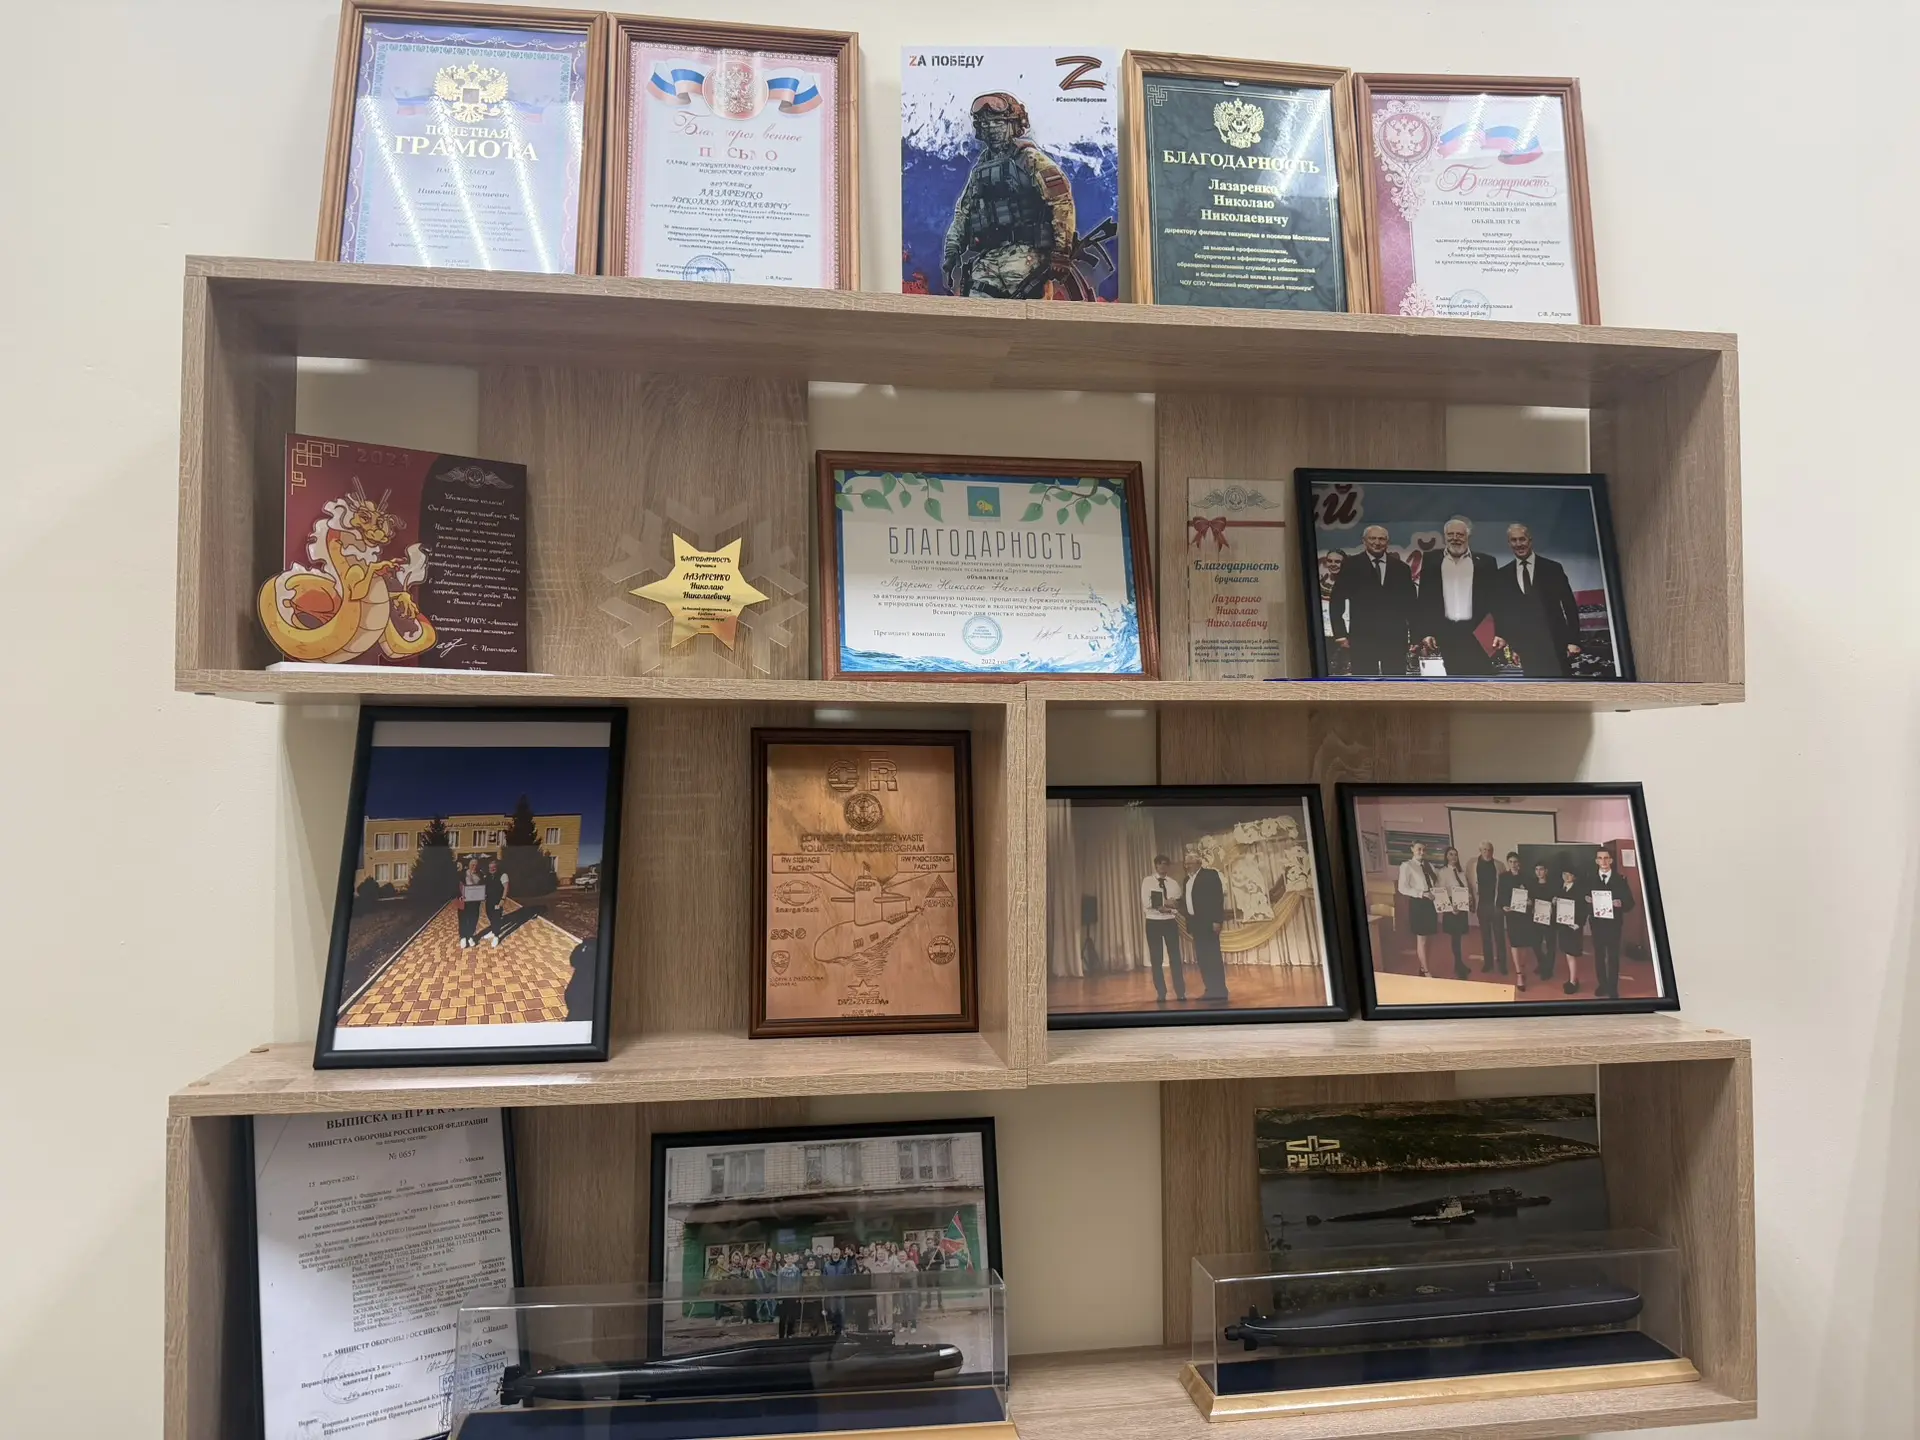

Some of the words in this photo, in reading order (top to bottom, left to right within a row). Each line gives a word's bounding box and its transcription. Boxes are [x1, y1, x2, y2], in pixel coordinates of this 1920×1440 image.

[931, 55, 984, 69] ПОБЕДУ
[1054, 55, 1107, 91] Z
[394, 135, 539, 161] ГРАМОТА
[1163, 150, 1320, 174] БЛАГОДАРНОСТЬ
[1208, 179, 1279, 195] Лазаренко
[1435, 164, 1557, 199] Благодарность
[698, 188, 763, 199] ЛАЗАРЕНКО
[672, 196, 719, 206] НИКОЛАЮ
[720, 199, 791, 210] НИКОЛАЕВИЧУ
[1214, 194, 1275, 210] Николаю
[1201, 208, 1289, 228] Николаевичу
[1164, 227, 1197, 236] директору
[888, 526, 1082, 561] БЛАГОДАРНОСТЬ
[680, 555, 732, 563] БЛАГОДАРНОСТЬ
[1194, 560, 1279, 574] Благодарность
[682, 572, 731, 581] ЛАЗАРЕНКО
[1214, 574, 1259, 585] вручается
[690, 581, 724, 591] Николаю
[881, 576, 933, 592] Лазаренко
[992, 581, 1062, 597] Николаевичу
[682, 591, 731, 602] Николаевичу
[1211, 594, 1262, 605] Лазаренко
[1216, 605, 1259, 615] Николаю
[1206, 618, 1268, 630] Николаевичу
[326, 1113, 388, 1130] ВЫПИСКА
[391, 1113, 402, 1121] из
[308, 1137, 352, 1149] МИНИСТРА
[354, 1131, 392, 1143] ОБОРОНЫ
[393, 1122, 444, 1137] РОССИЙСКОЙ
[445, 1117, 488, 1130] ФЕДЕРАЦИИ
[1287, 1152, 1342, 1168] РУБИН
[475, 1362, 505, 1376] ВЕРНА
